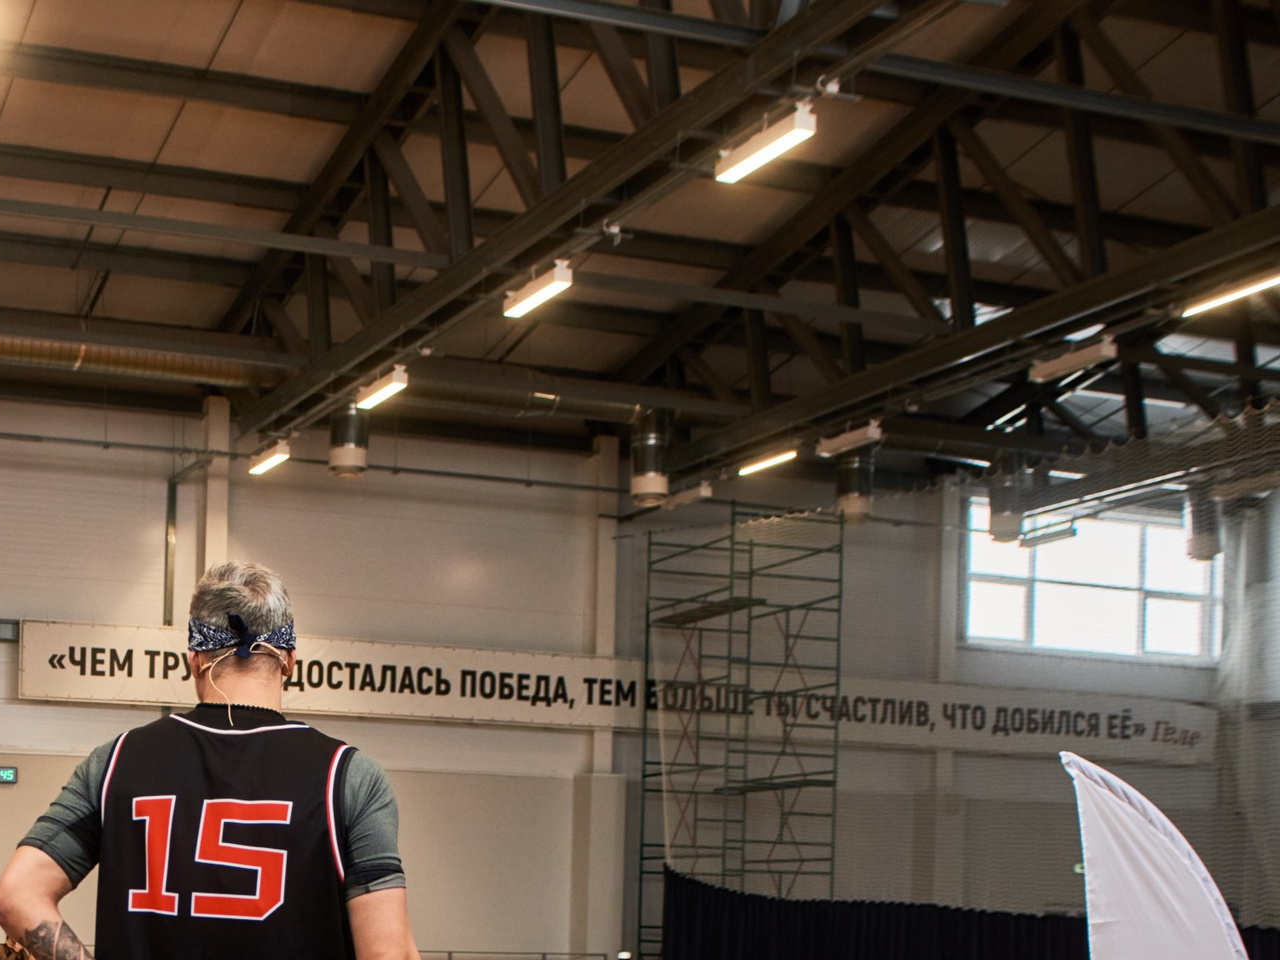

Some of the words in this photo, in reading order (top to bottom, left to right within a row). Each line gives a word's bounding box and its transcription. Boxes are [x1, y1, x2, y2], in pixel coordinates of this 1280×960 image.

[48, 645, 134, 679] «ЧЕМ
[283, 659, 452, 696] ДОСТАЛАСЬ
[460, 669, 575, 709] ПОБЕДА,
[584, 676, 637, 708] ТЕМ
[806, 692, 935, 731] СЧАСТЛИВ,
[943, 704, 986, 732] ЧТО
[992, 706, 1100, 738] ДОБИЛСЯ
[128, 795, 293, 920] 15
